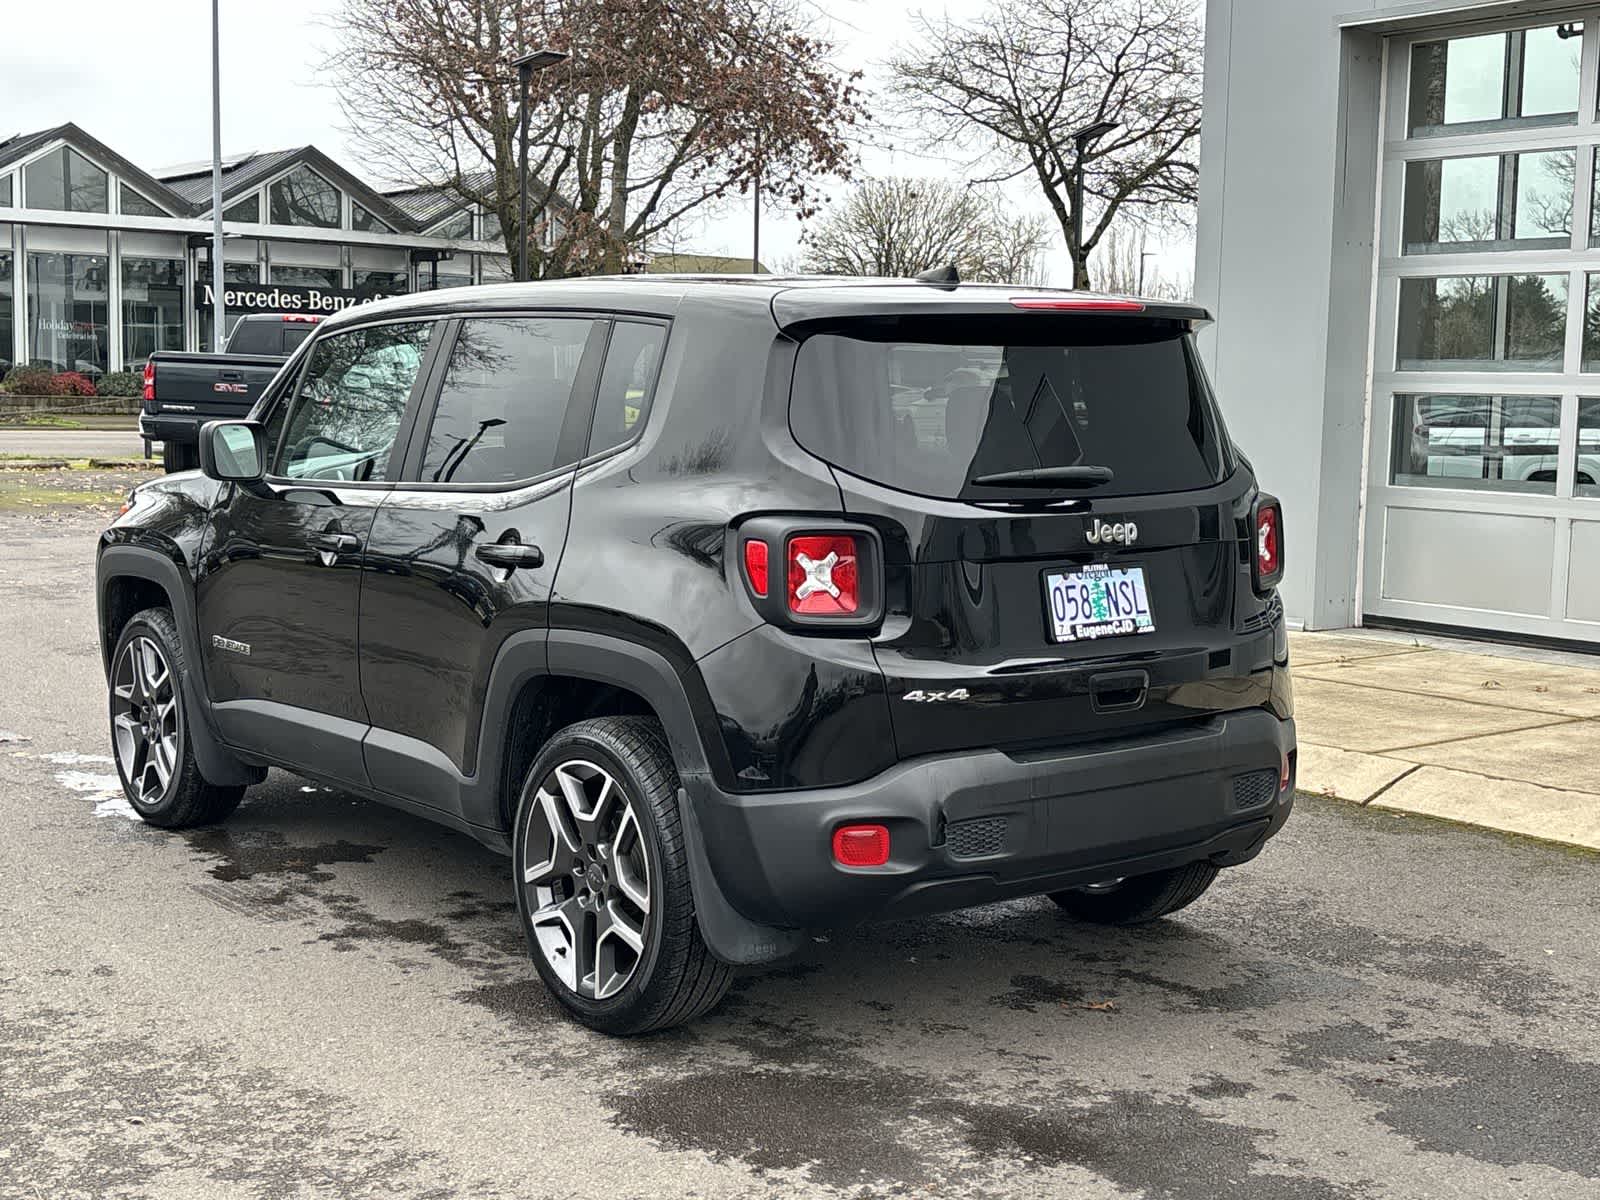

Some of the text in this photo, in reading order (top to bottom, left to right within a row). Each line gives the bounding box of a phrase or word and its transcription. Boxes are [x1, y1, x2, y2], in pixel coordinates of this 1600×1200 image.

[203, 284, 354, 311] Mercedes-Benz
[38, 319, 75, 334] Holiday
[214, 381, 248, 392] GMC
[1085, 518, 1138, 545] Jeep
[1053, 580, 1147, 622] 058 NSL
[1075, 619, 1134, 639] EugeneCJD
[902, 687, 970, 703] 4x4
